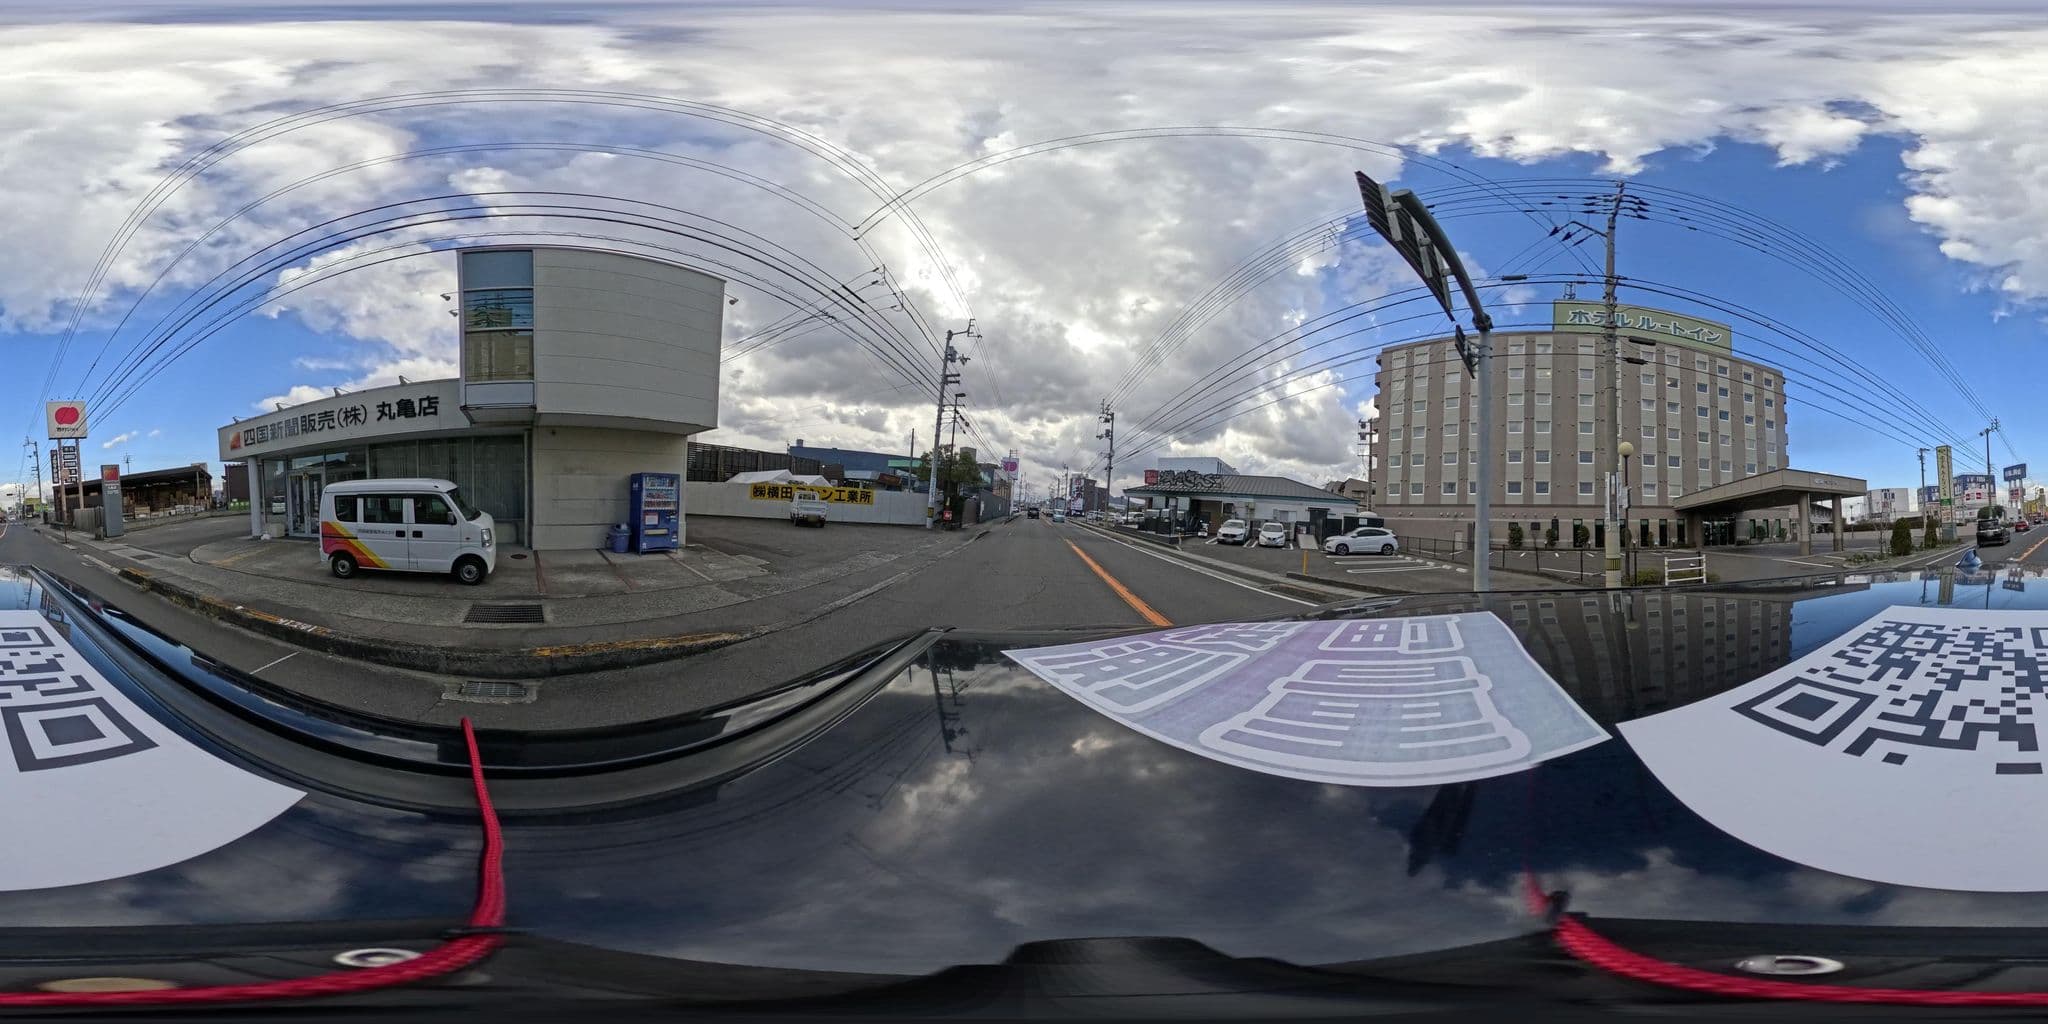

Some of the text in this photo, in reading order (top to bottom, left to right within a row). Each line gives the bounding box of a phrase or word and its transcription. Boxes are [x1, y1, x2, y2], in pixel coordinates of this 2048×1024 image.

[1637, 315, 1722, 343] ルートイン
[376, 395, 439, 422] 丸亀店
